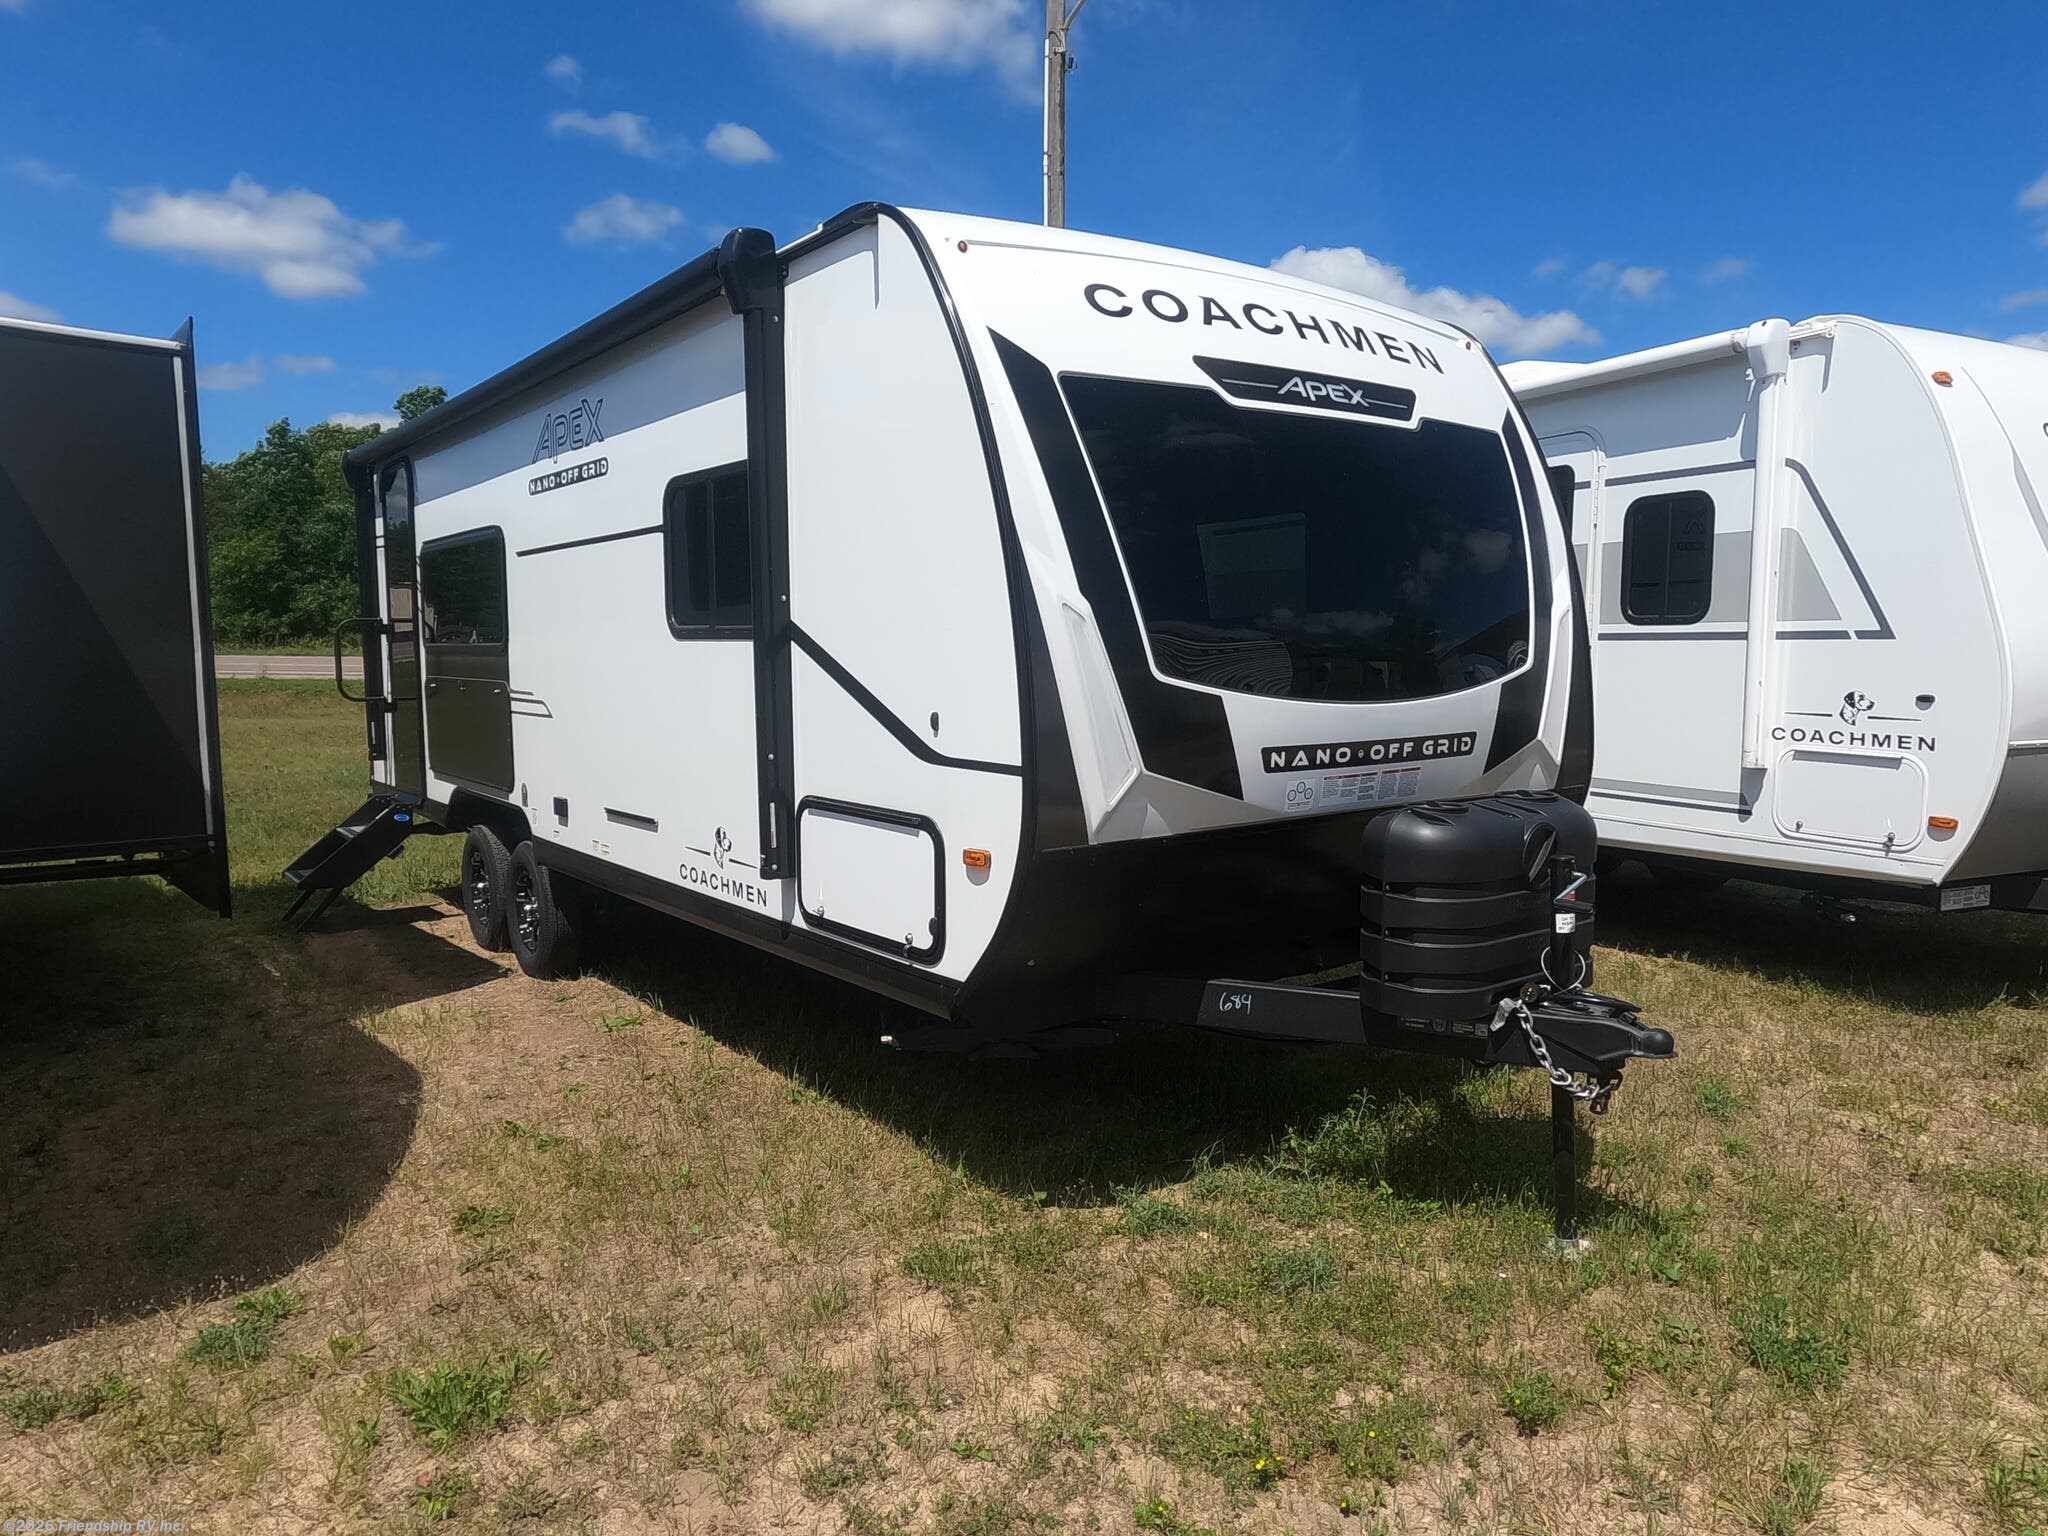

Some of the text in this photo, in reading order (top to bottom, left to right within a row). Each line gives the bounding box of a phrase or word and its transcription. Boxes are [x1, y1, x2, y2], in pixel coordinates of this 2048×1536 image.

[1084, 283, 1446, 375] COACHMEN
[1277, 375, 1370, 407] APEX
[532, 398, 605, 464] APEX
[581, 460, 607, 478] GRID
[1422, 736, 1472, 755] GRID
[1771, 727, 1936, 751] COACHMEN
[679, 863, 767, 907] COACHMEN
